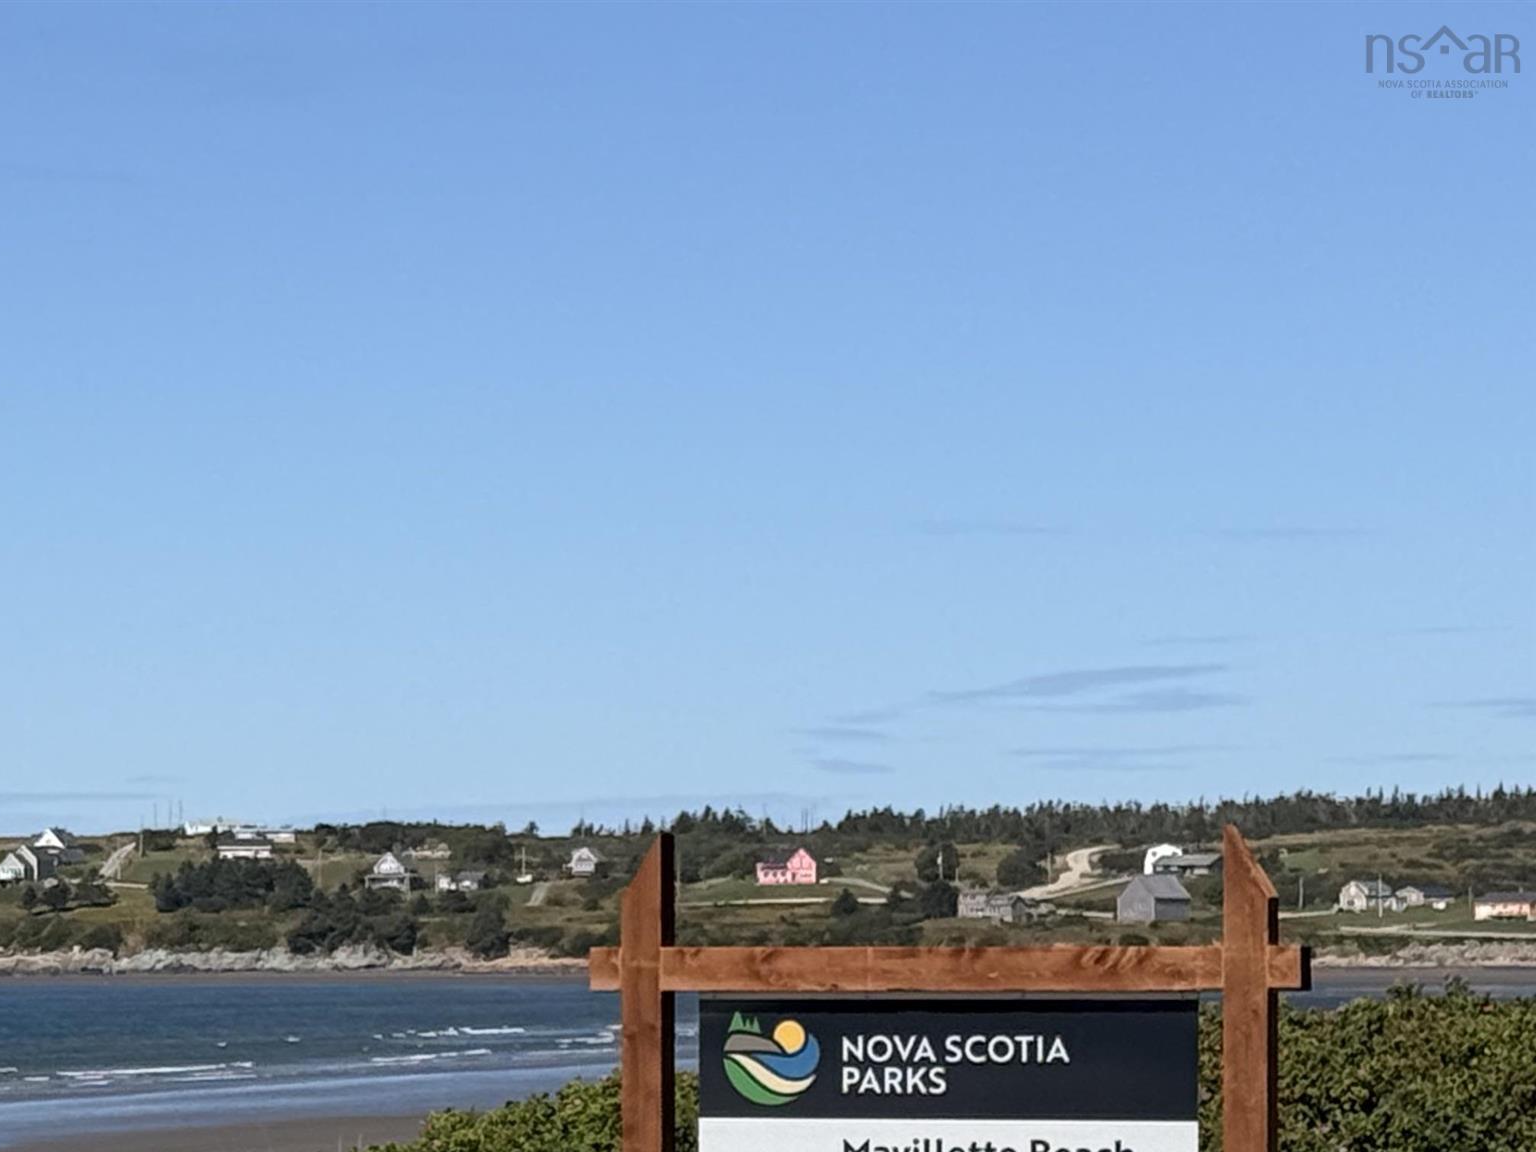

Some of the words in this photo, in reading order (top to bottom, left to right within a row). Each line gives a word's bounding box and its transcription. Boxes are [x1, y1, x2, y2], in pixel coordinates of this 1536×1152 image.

[842, 1035, 937, 1063] NOVA
[944, 1035, 1070, 1064] SCOTIA
[842, 1066, 947, 1095] PARKS
